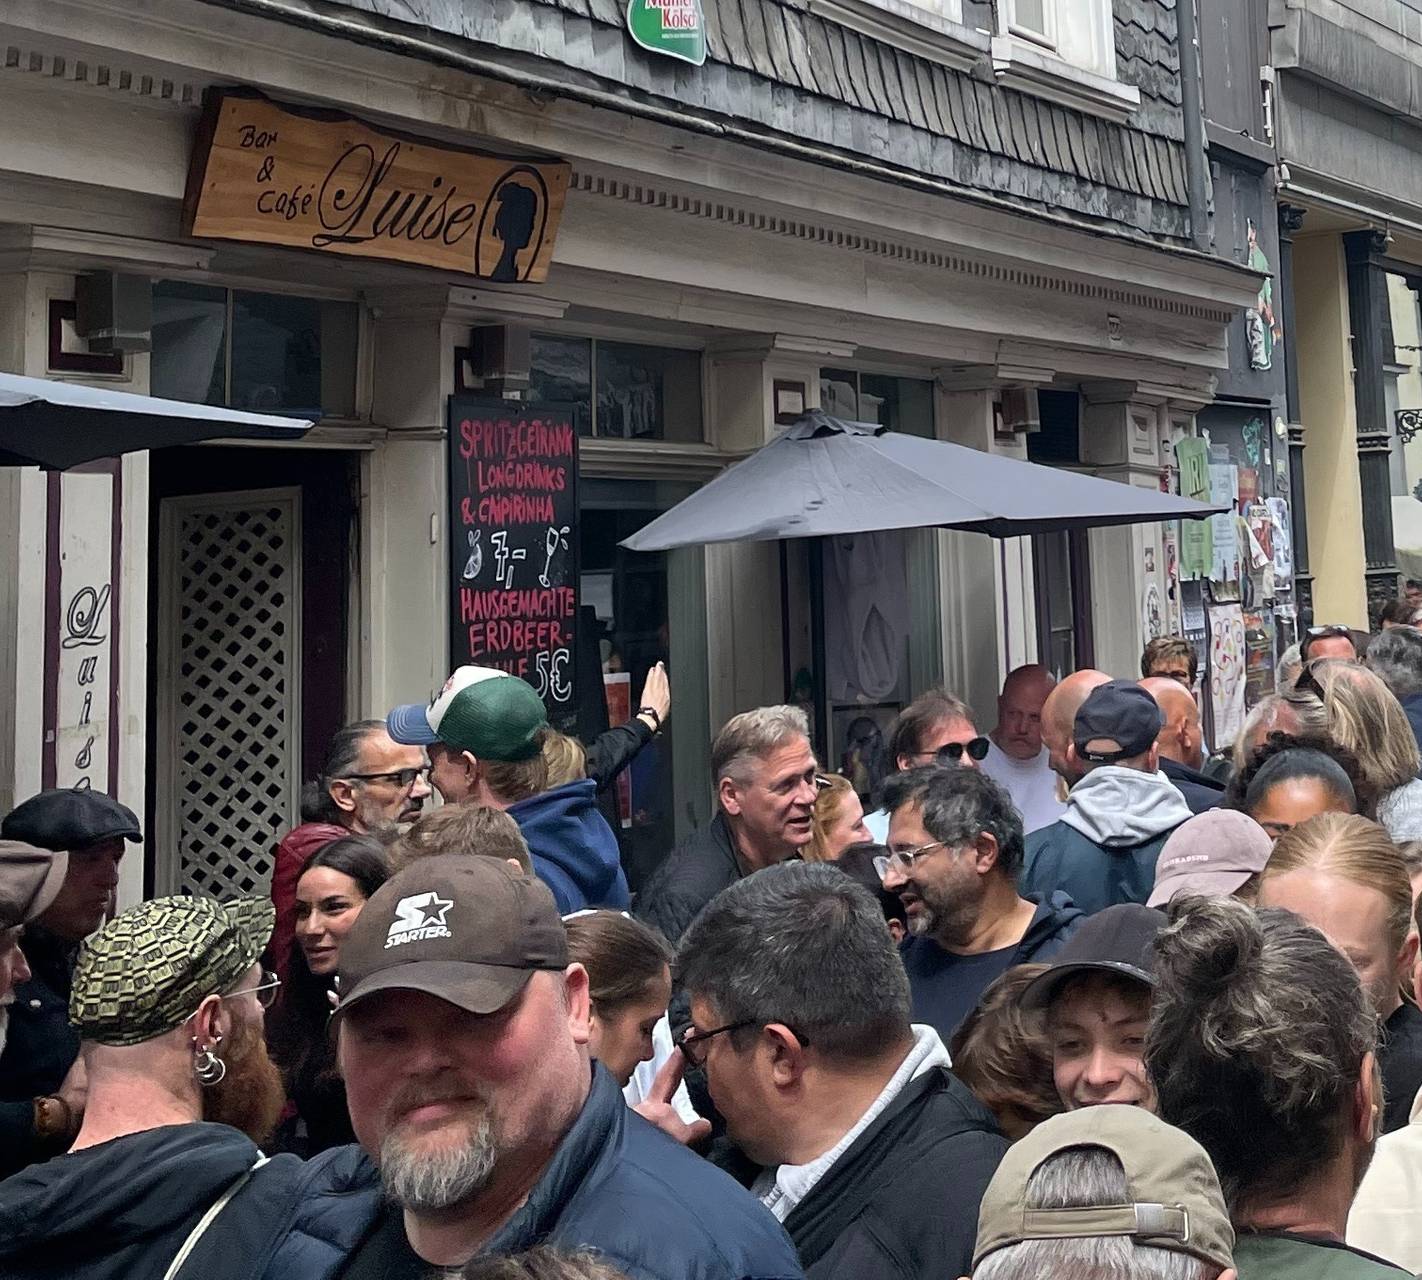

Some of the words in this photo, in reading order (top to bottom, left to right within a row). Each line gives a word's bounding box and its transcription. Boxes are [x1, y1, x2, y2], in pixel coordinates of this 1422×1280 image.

[239, 125, 278, 148] Bar
[256, 156, 275, 183] &
[256, 183, 316, 220] Café
[312, 141, 476, 247] Luise
[460, 497, 476, 525] &
[460, 586, 575, 624] HAUSGEMACHTE
